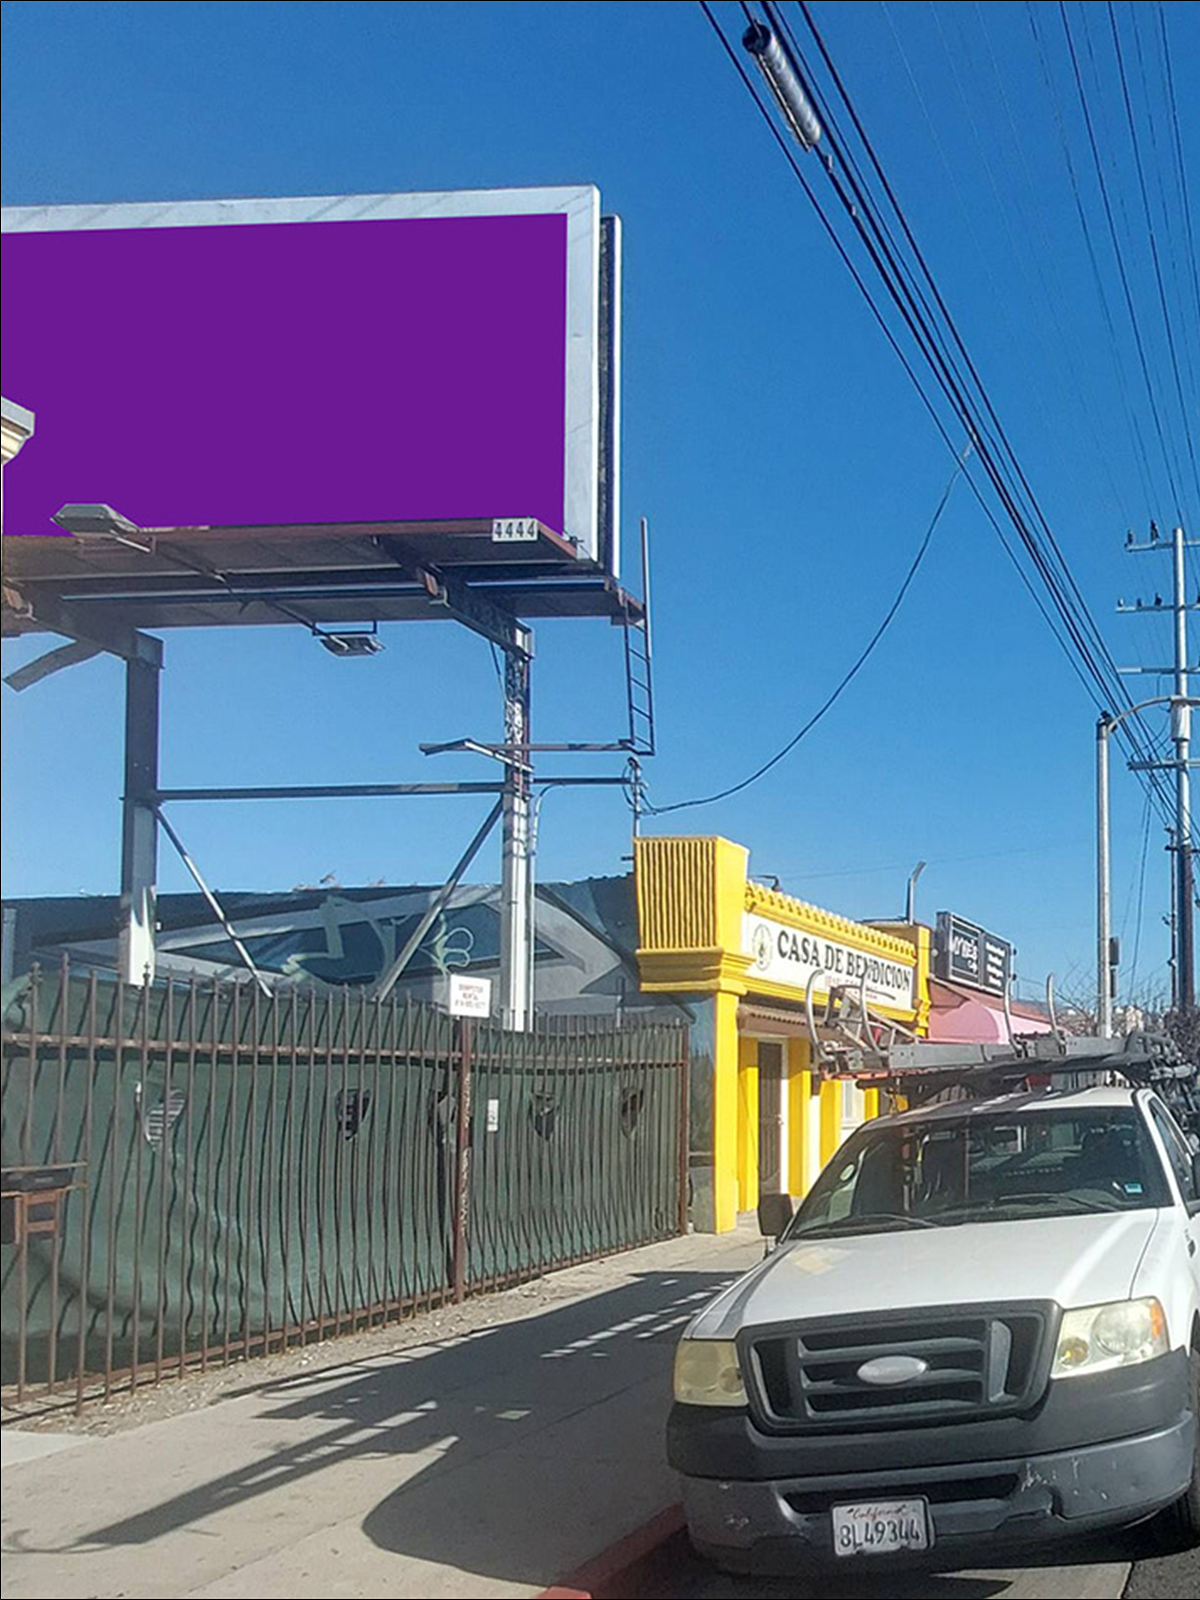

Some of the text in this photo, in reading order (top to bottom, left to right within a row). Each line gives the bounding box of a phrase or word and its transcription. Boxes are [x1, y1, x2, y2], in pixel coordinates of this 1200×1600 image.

[495, 520, 536, 539] 4444
[777, 930, 821, 968] CASA
[824, 944, 844, 974] DE
[846, 951, 911, 992] BENDICION
[840, 1519, 921, 1549] 8L49344
